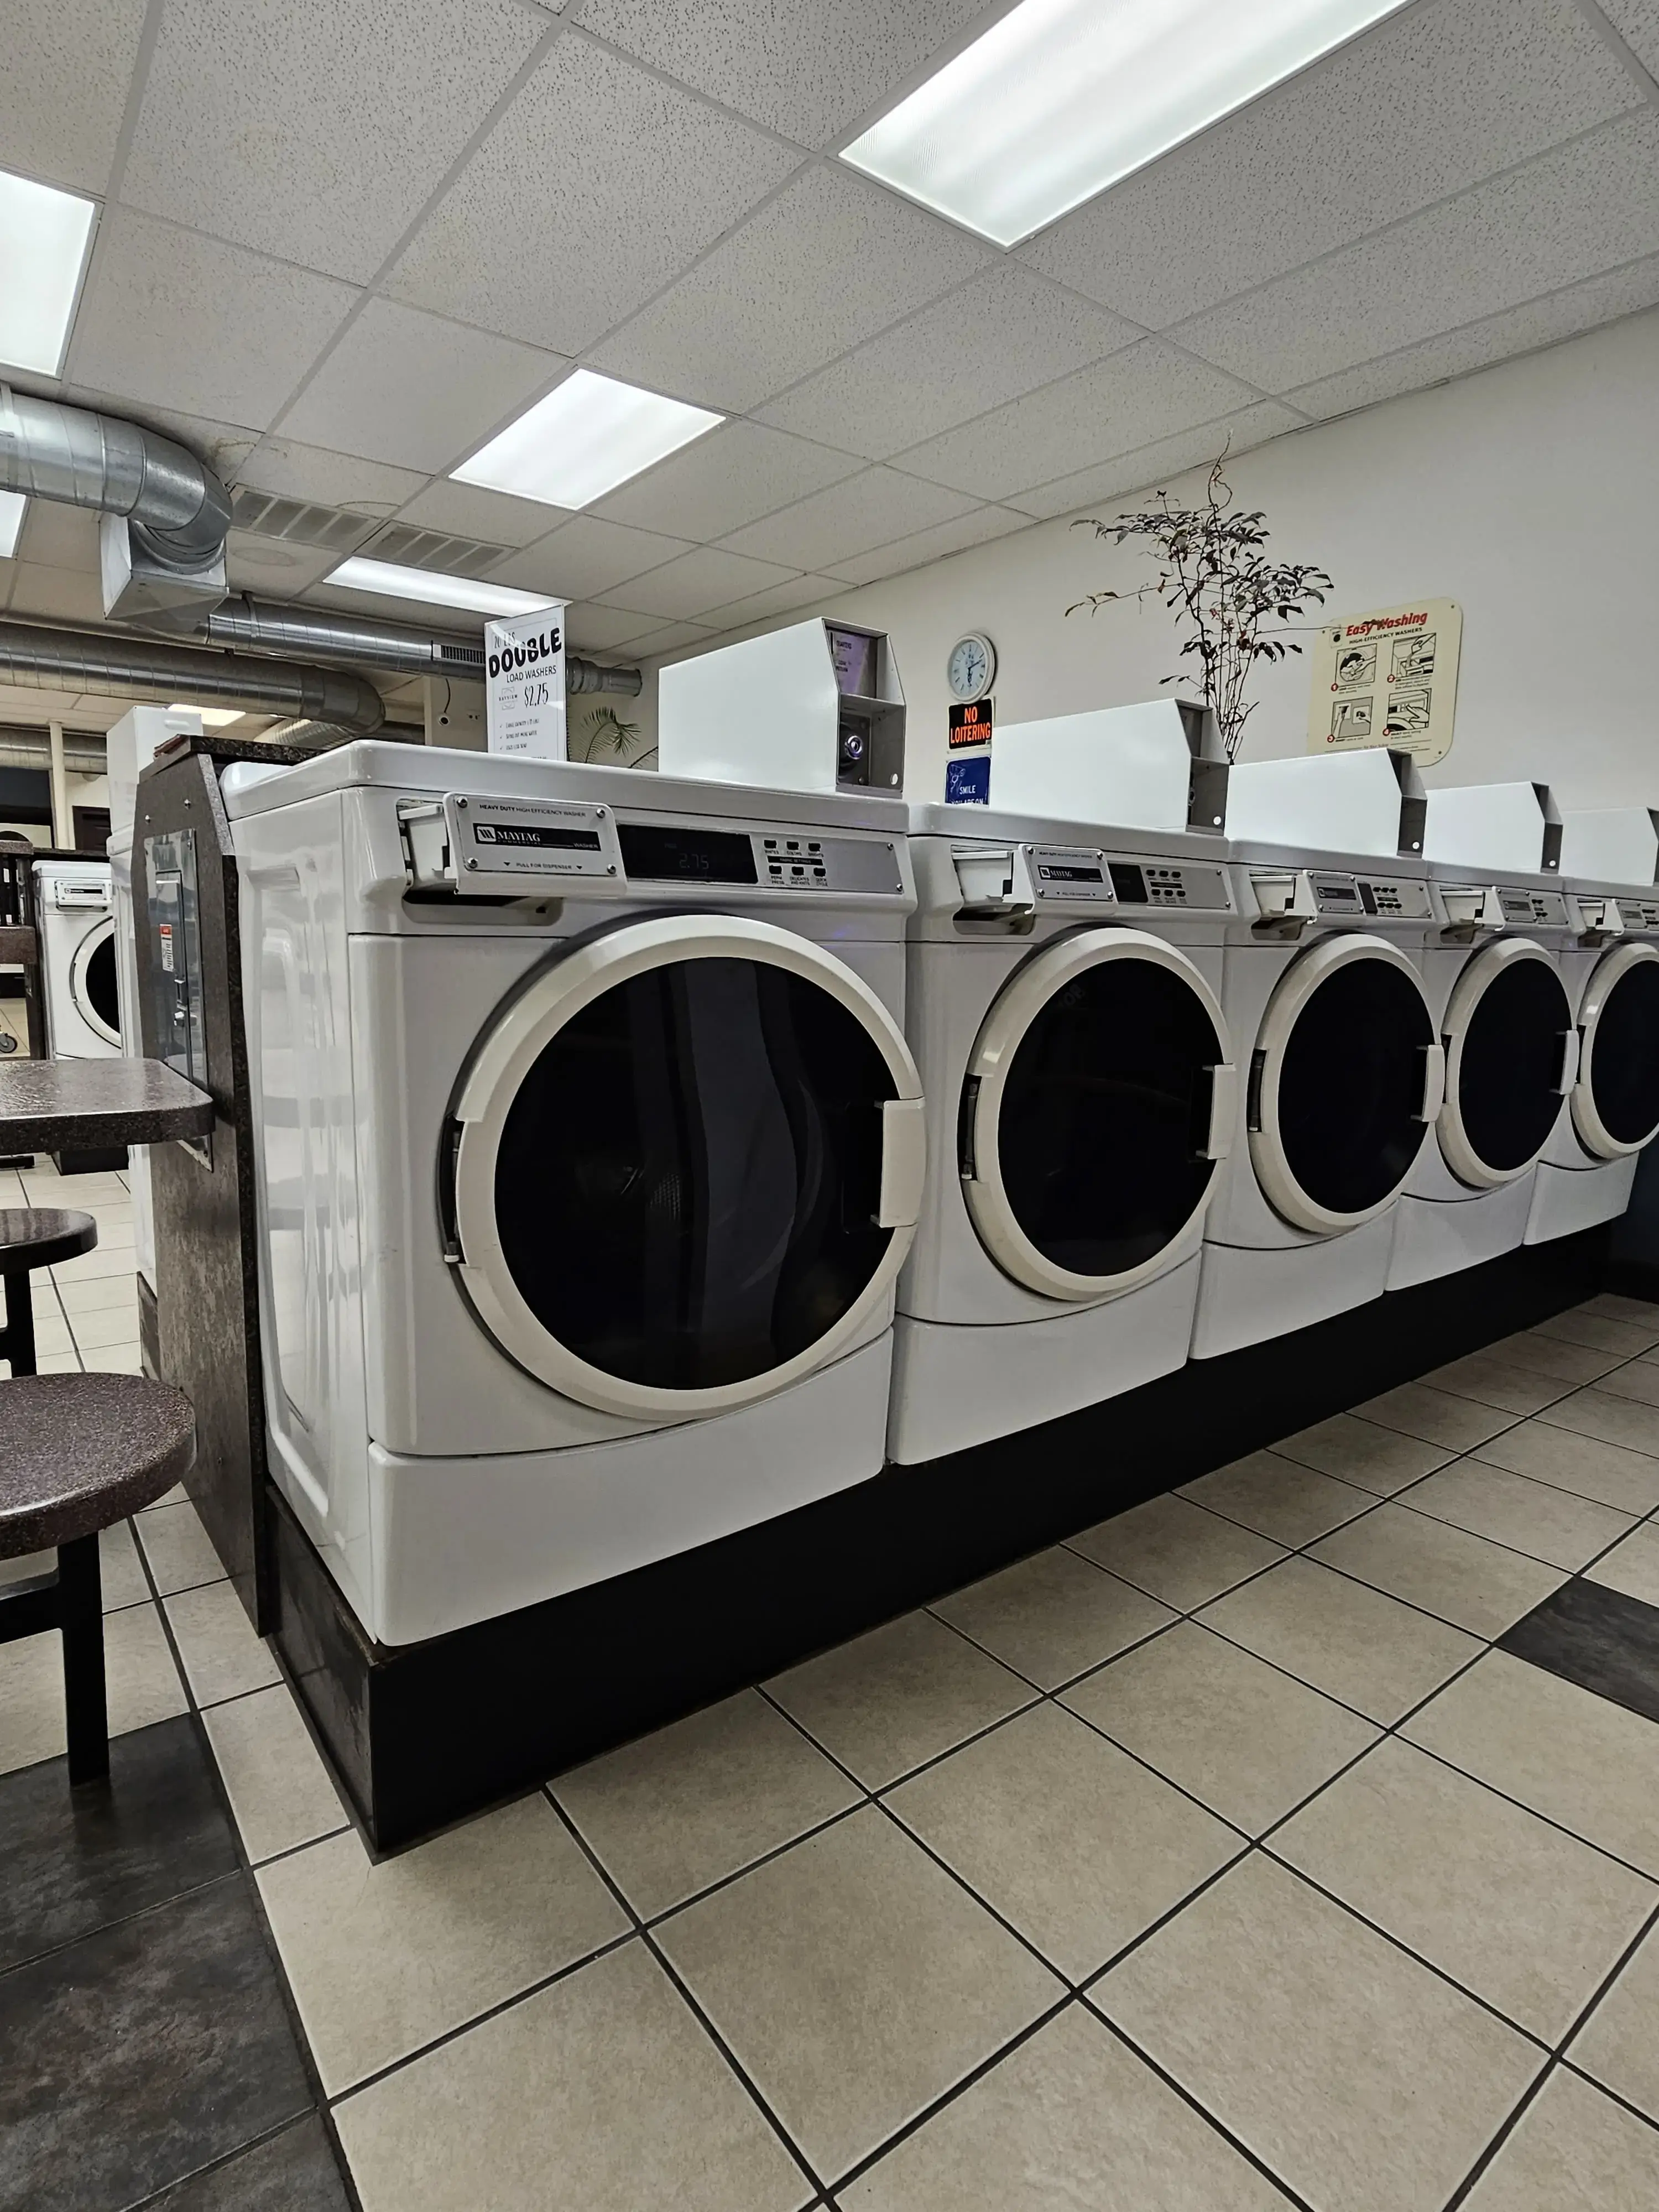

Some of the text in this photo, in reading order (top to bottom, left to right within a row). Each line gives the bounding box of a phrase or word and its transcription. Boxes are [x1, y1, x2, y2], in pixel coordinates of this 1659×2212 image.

[1346, 613, 1428, 636] Easy Washing
[1349, 632, 1395, 644] HIGH-EFFICIENCY
[1395, 627, 1423, 636] WASHERS
[489, 627, 562, 678] DOUBLE
[507, 665, 556, 683] LOAD WASHERS
[524, 682, 549, 708] $2.75
[964, 706, 978, 724] NO
[951, 722, 990, 744] LOITERING
[959, 785, 976, 795] SMILE
[497, 831, 540, 842] MAYTAG
[679, 853, 709, 869] 2.75
